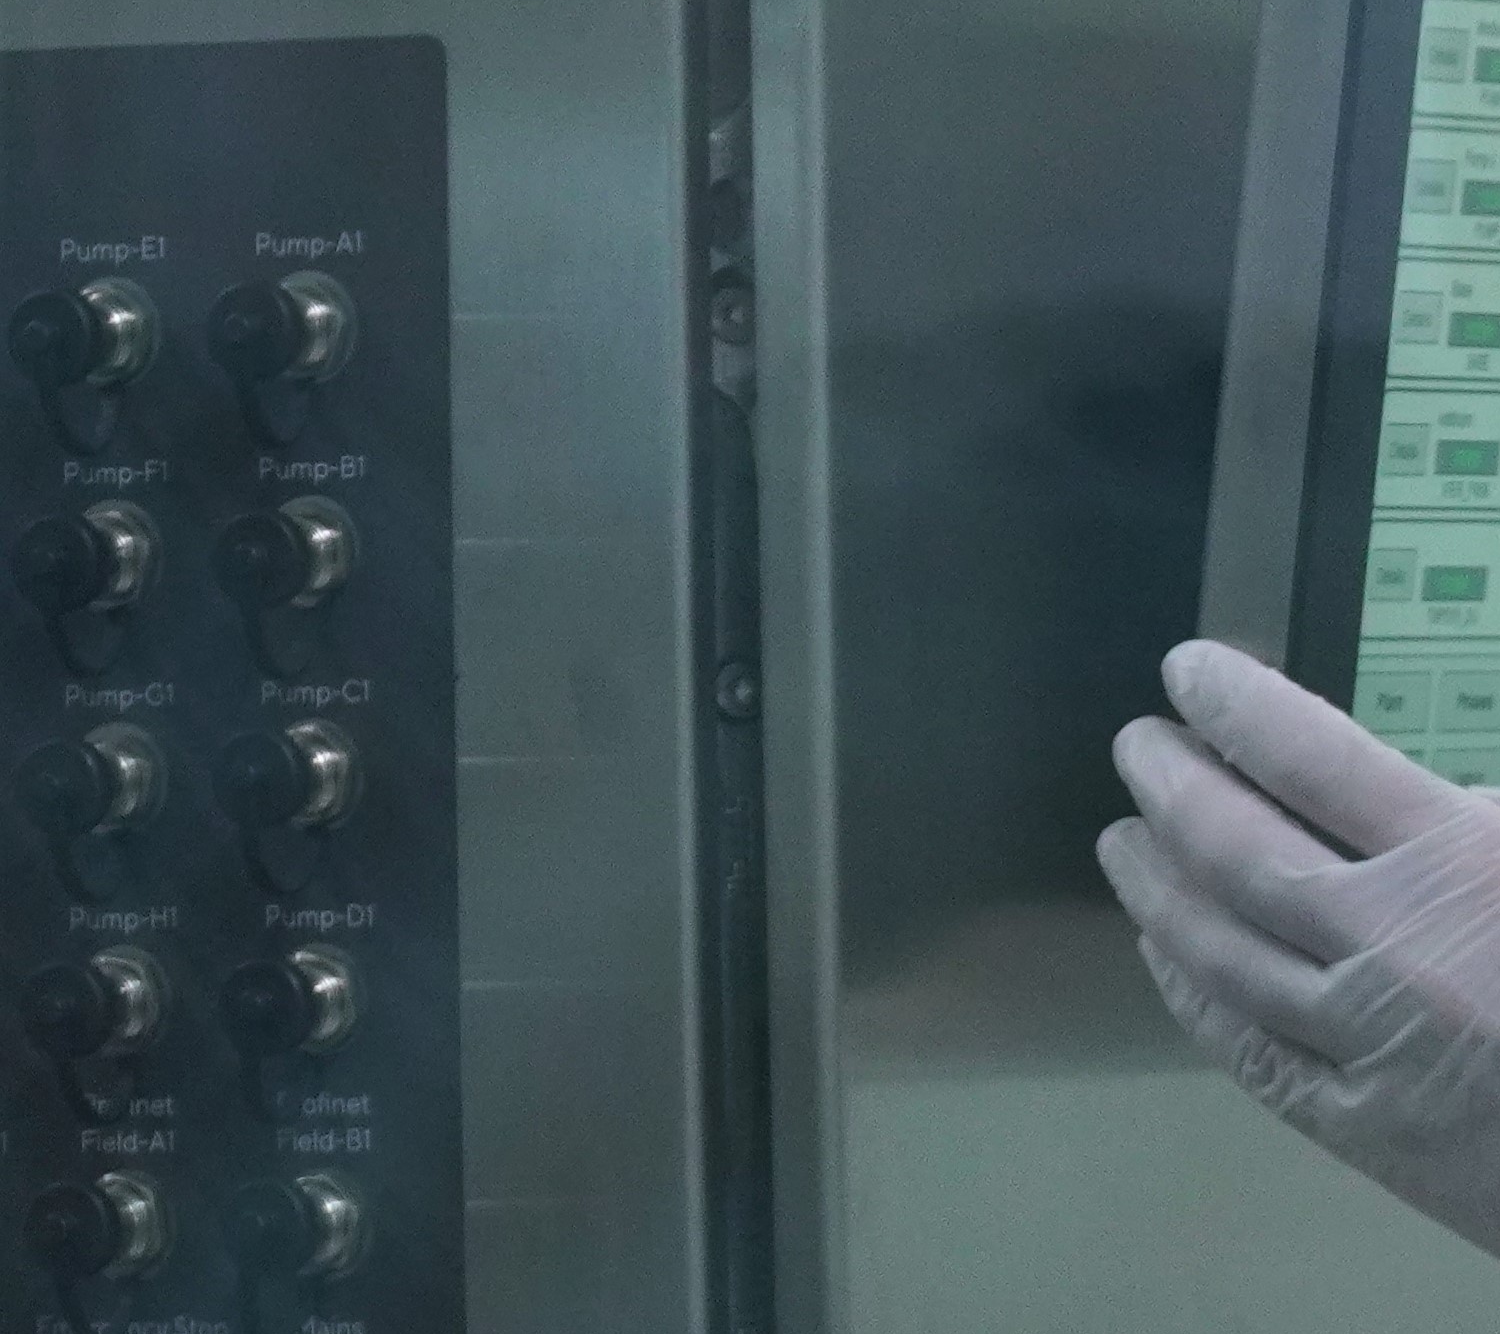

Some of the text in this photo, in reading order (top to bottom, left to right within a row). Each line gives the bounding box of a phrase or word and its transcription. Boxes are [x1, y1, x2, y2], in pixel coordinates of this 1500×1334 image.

[59, 235, 167, 265] Pump-E1
[254, 229, 365, 260] Pump-A1
[62, 459, 168, 488] Pump-F1
[258, 454, 366, 482] Pump-B1
[260, 678, 371, 708] Pump-C1
[68, 905, 178, 933] Pump-H1
[264, 902, 376, 930] Pump-D1
[80, 1126, 176, 1154] Field-A1
